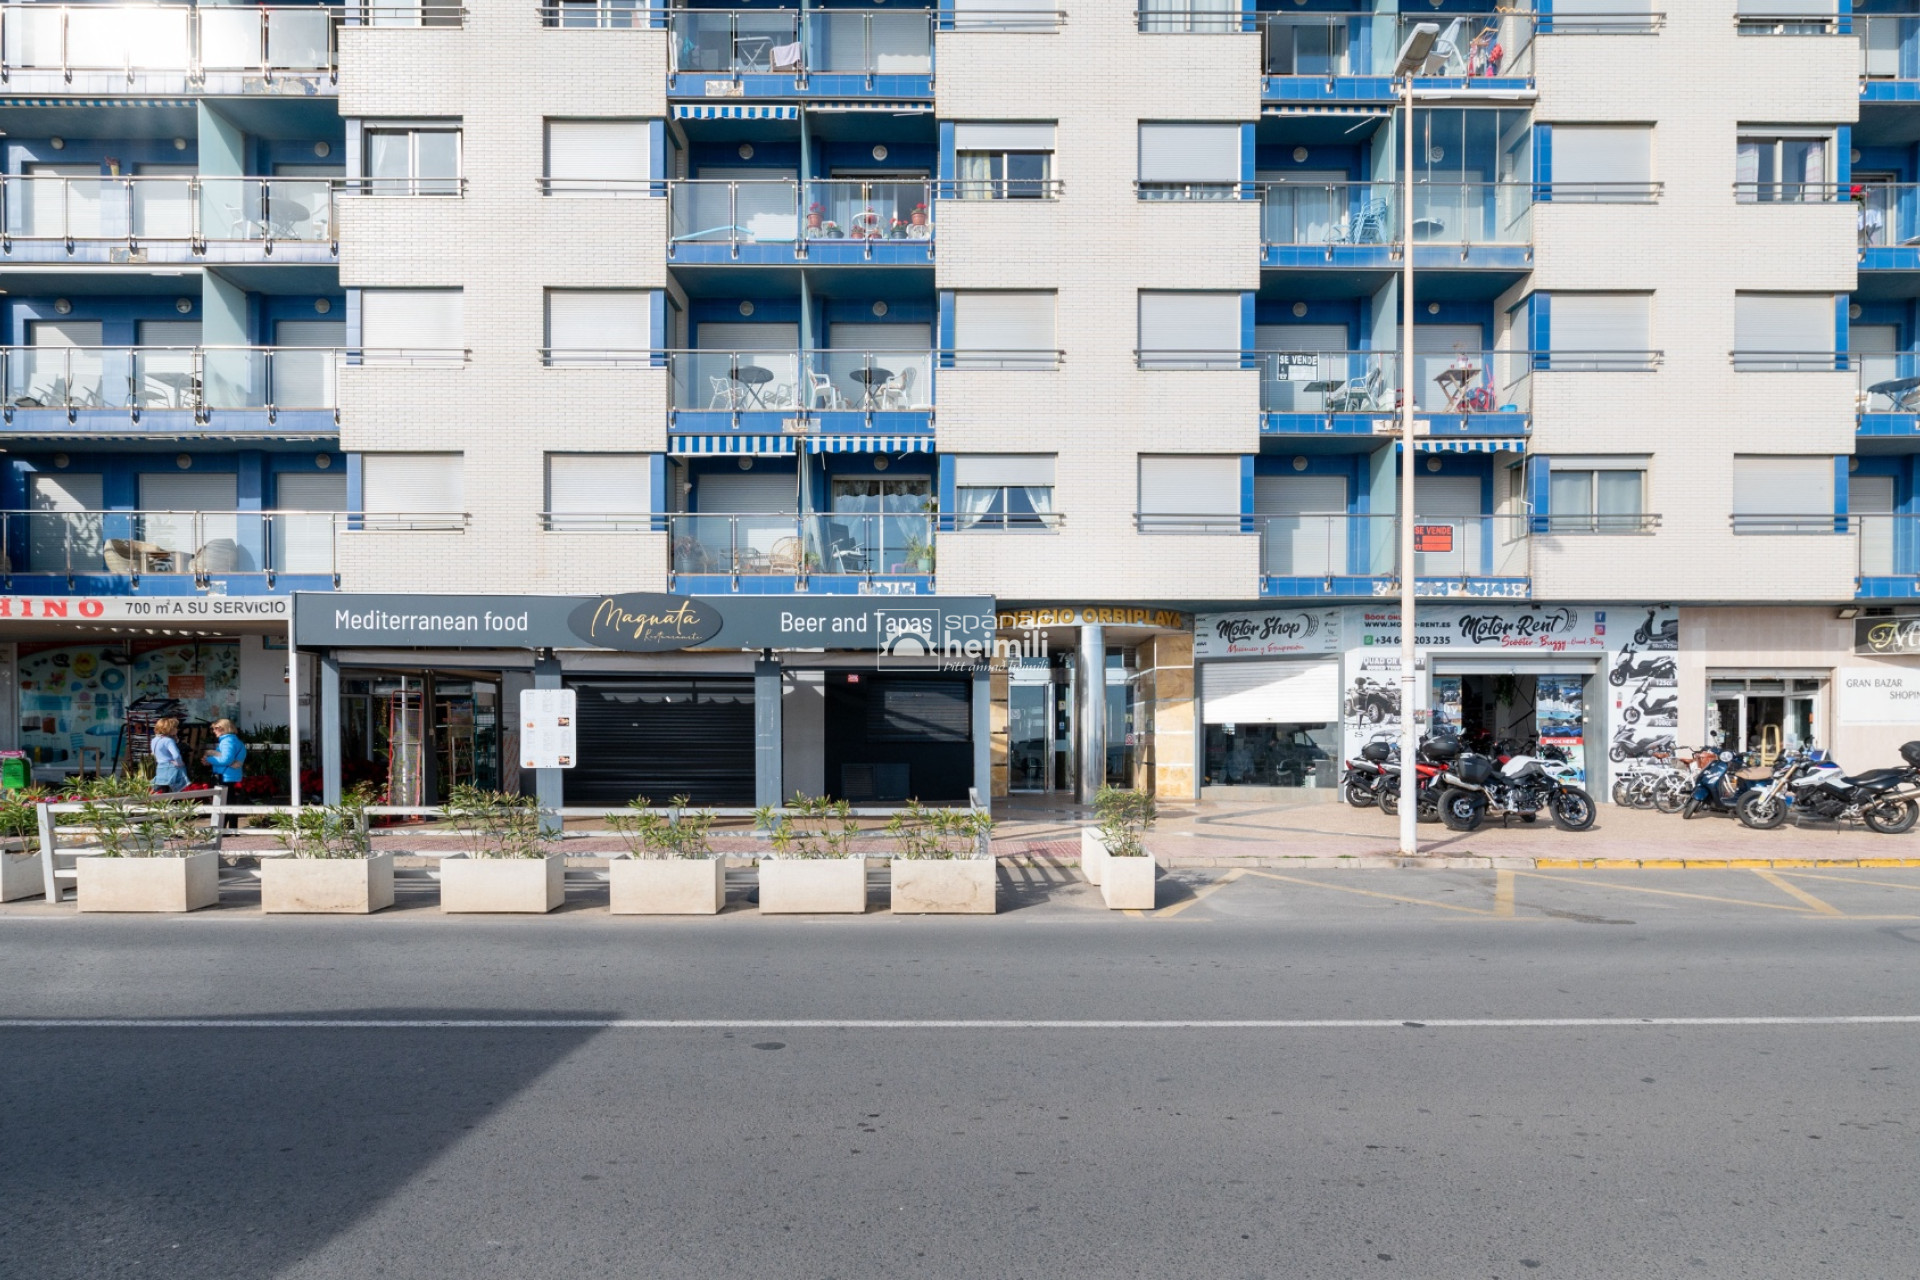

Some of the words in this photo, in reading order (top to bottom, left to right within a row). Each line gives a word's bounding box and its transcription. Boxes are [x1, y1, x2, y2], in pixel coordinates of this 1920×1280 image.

[1280, 355, 1289, 364] SE
[1292, 355, 1318, 365] VENDE
[1415, 526, 1424, 534] SE
[1426, 526, 1452, 535] VENDE
[125, 602, 150, 614] 700
[173, 602, 183, 614] A
[187, 602, 208, 614] SU
[591, 598, 701, 639] Magnata
[1082, 607, 1182, 628] ORBIPLAYA
[335, 609, 478, 631] Mediterranean
[484, 610, 528, 631] food
[781, 612, 827, 633] Beer
[831, 612, 867, 633] and
[873, 612, 932, 637] Tapas
[1216, 618, 1260, 643] Motor
[1259, 616, 1301, 640] Shop
[1458, 614, 1514, 645] Motor
[1515, 614, 1564, 637] Rent
[1375, 636, 1392, 644] +34
[1414, 636, 1431, 644] 203
[1433, 636, 1451, 644] 235
[1846, 678, 1871, 688] GRAN
[1874, 678, 1903, 687] BAZAR
